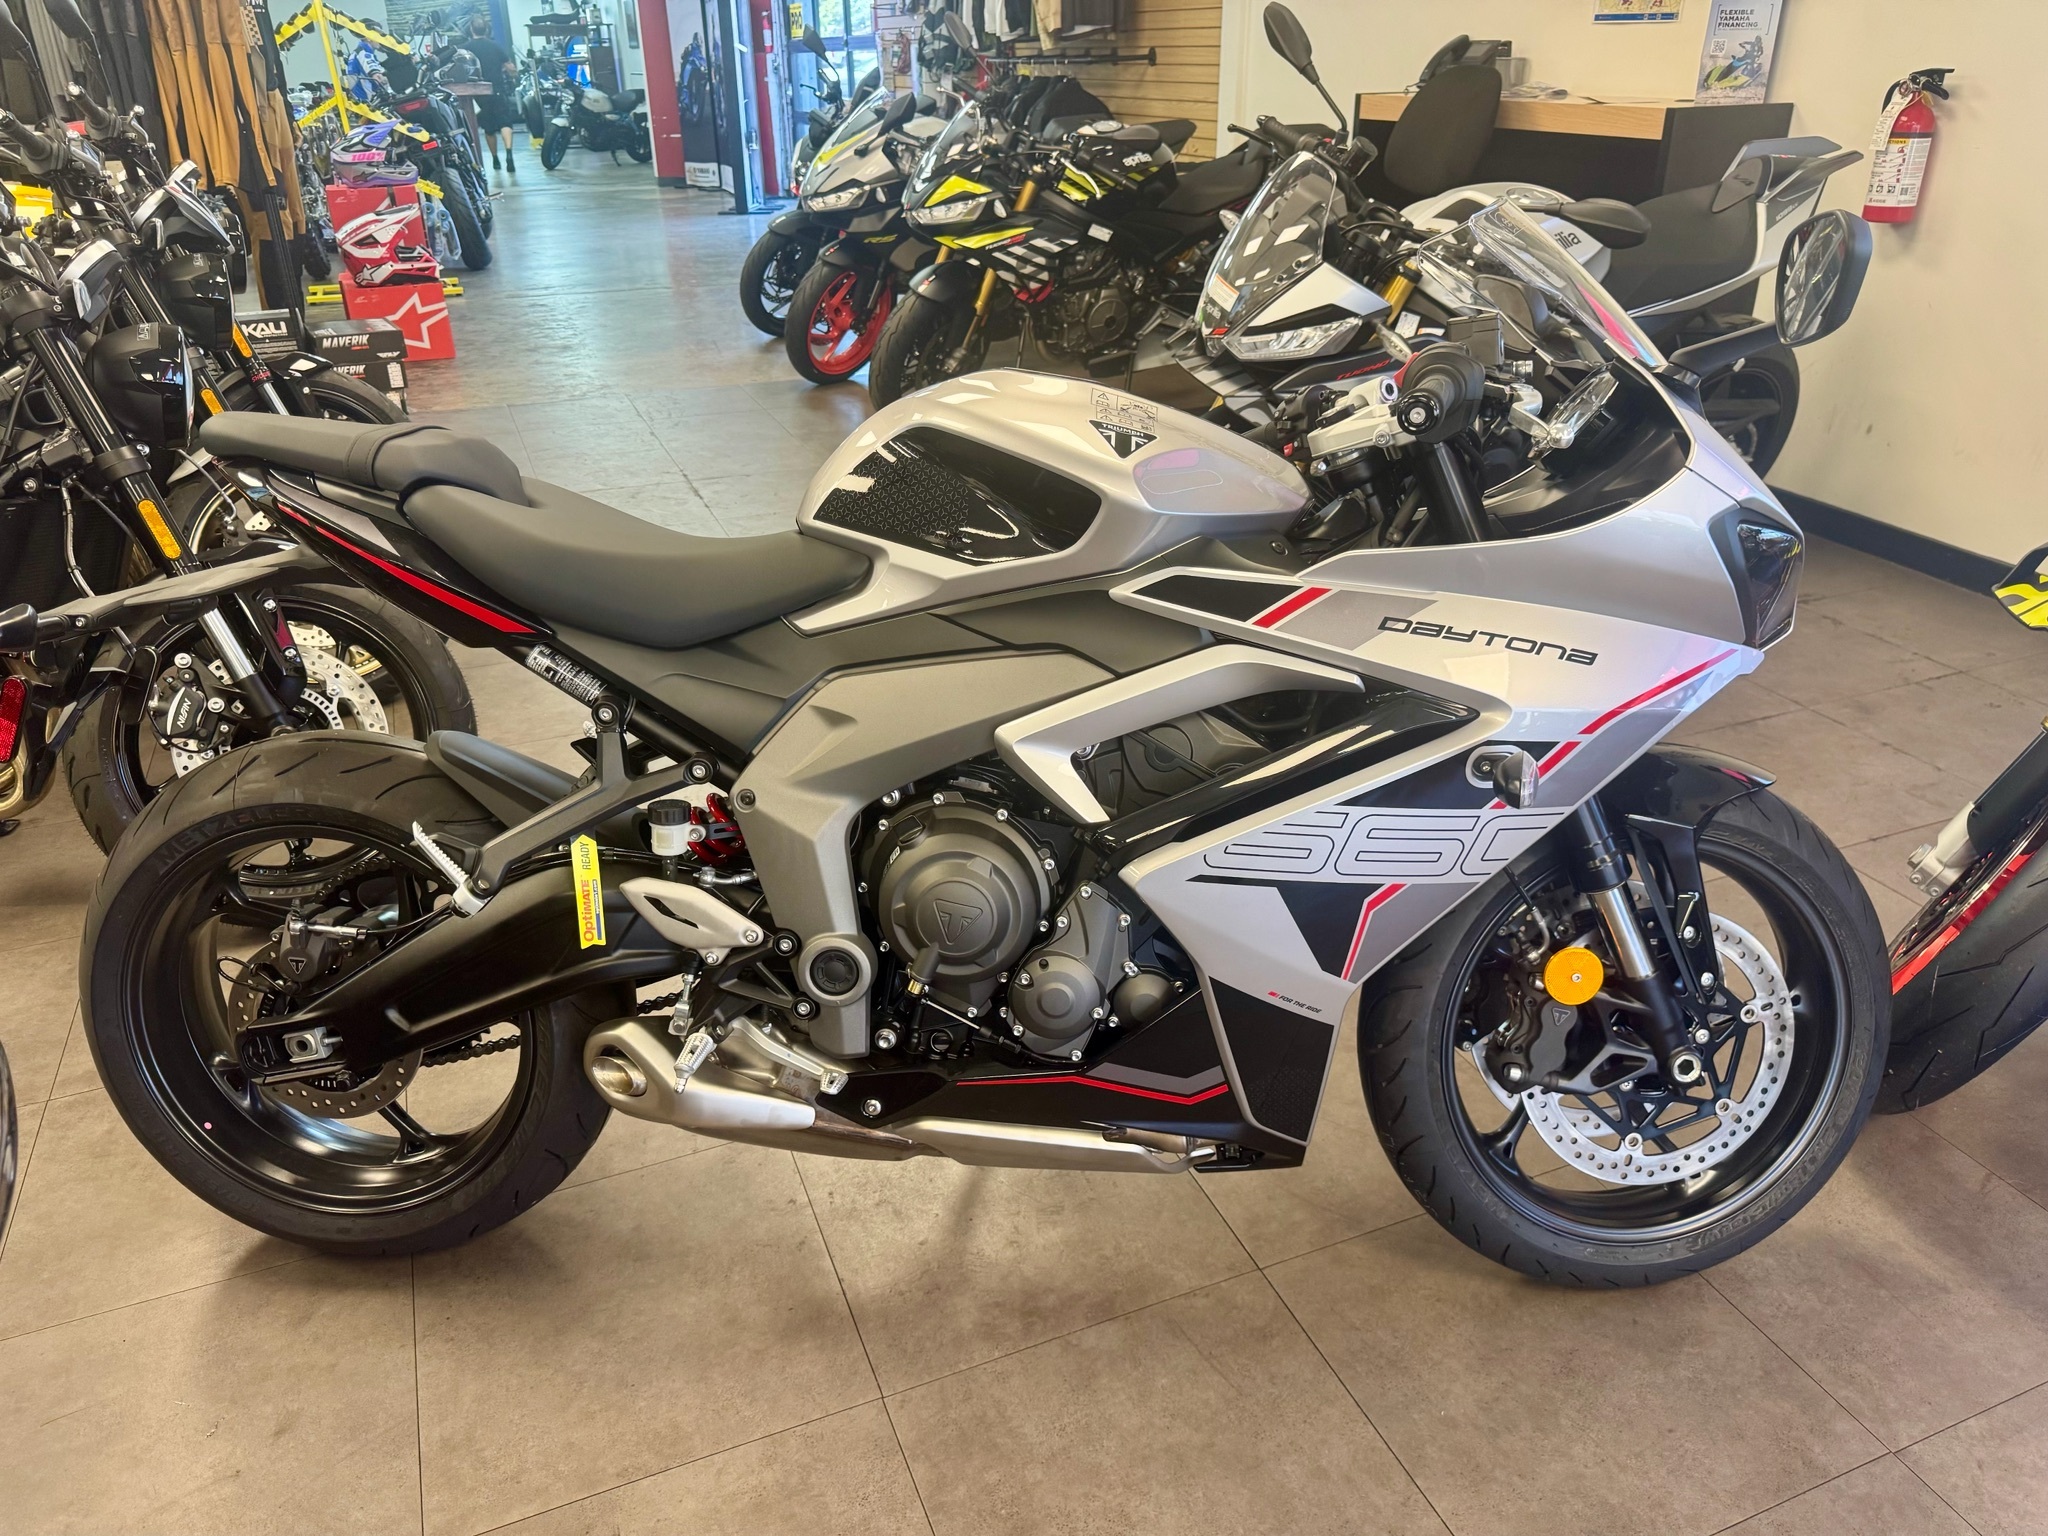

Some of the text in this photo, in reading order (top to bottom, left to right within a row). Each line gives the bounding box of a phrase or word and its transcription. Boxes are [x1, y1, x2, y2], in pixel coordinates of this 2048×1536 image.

[351, 150, 385, 162] 100%
[240, 320, 288, 338] KALI
[322, 334, 370, 349] MAVERIK
[331, 364, 367, 379] AVERIK
[1336, 358, 1391, 381] TUONO
[1101, 423, 1145, 437] TRIUMPH
[579, 841, 592, 870] READY
[1279, 995, 1293, 1003] FOR
[1305, 1005, 1322, 1013] RIDE
